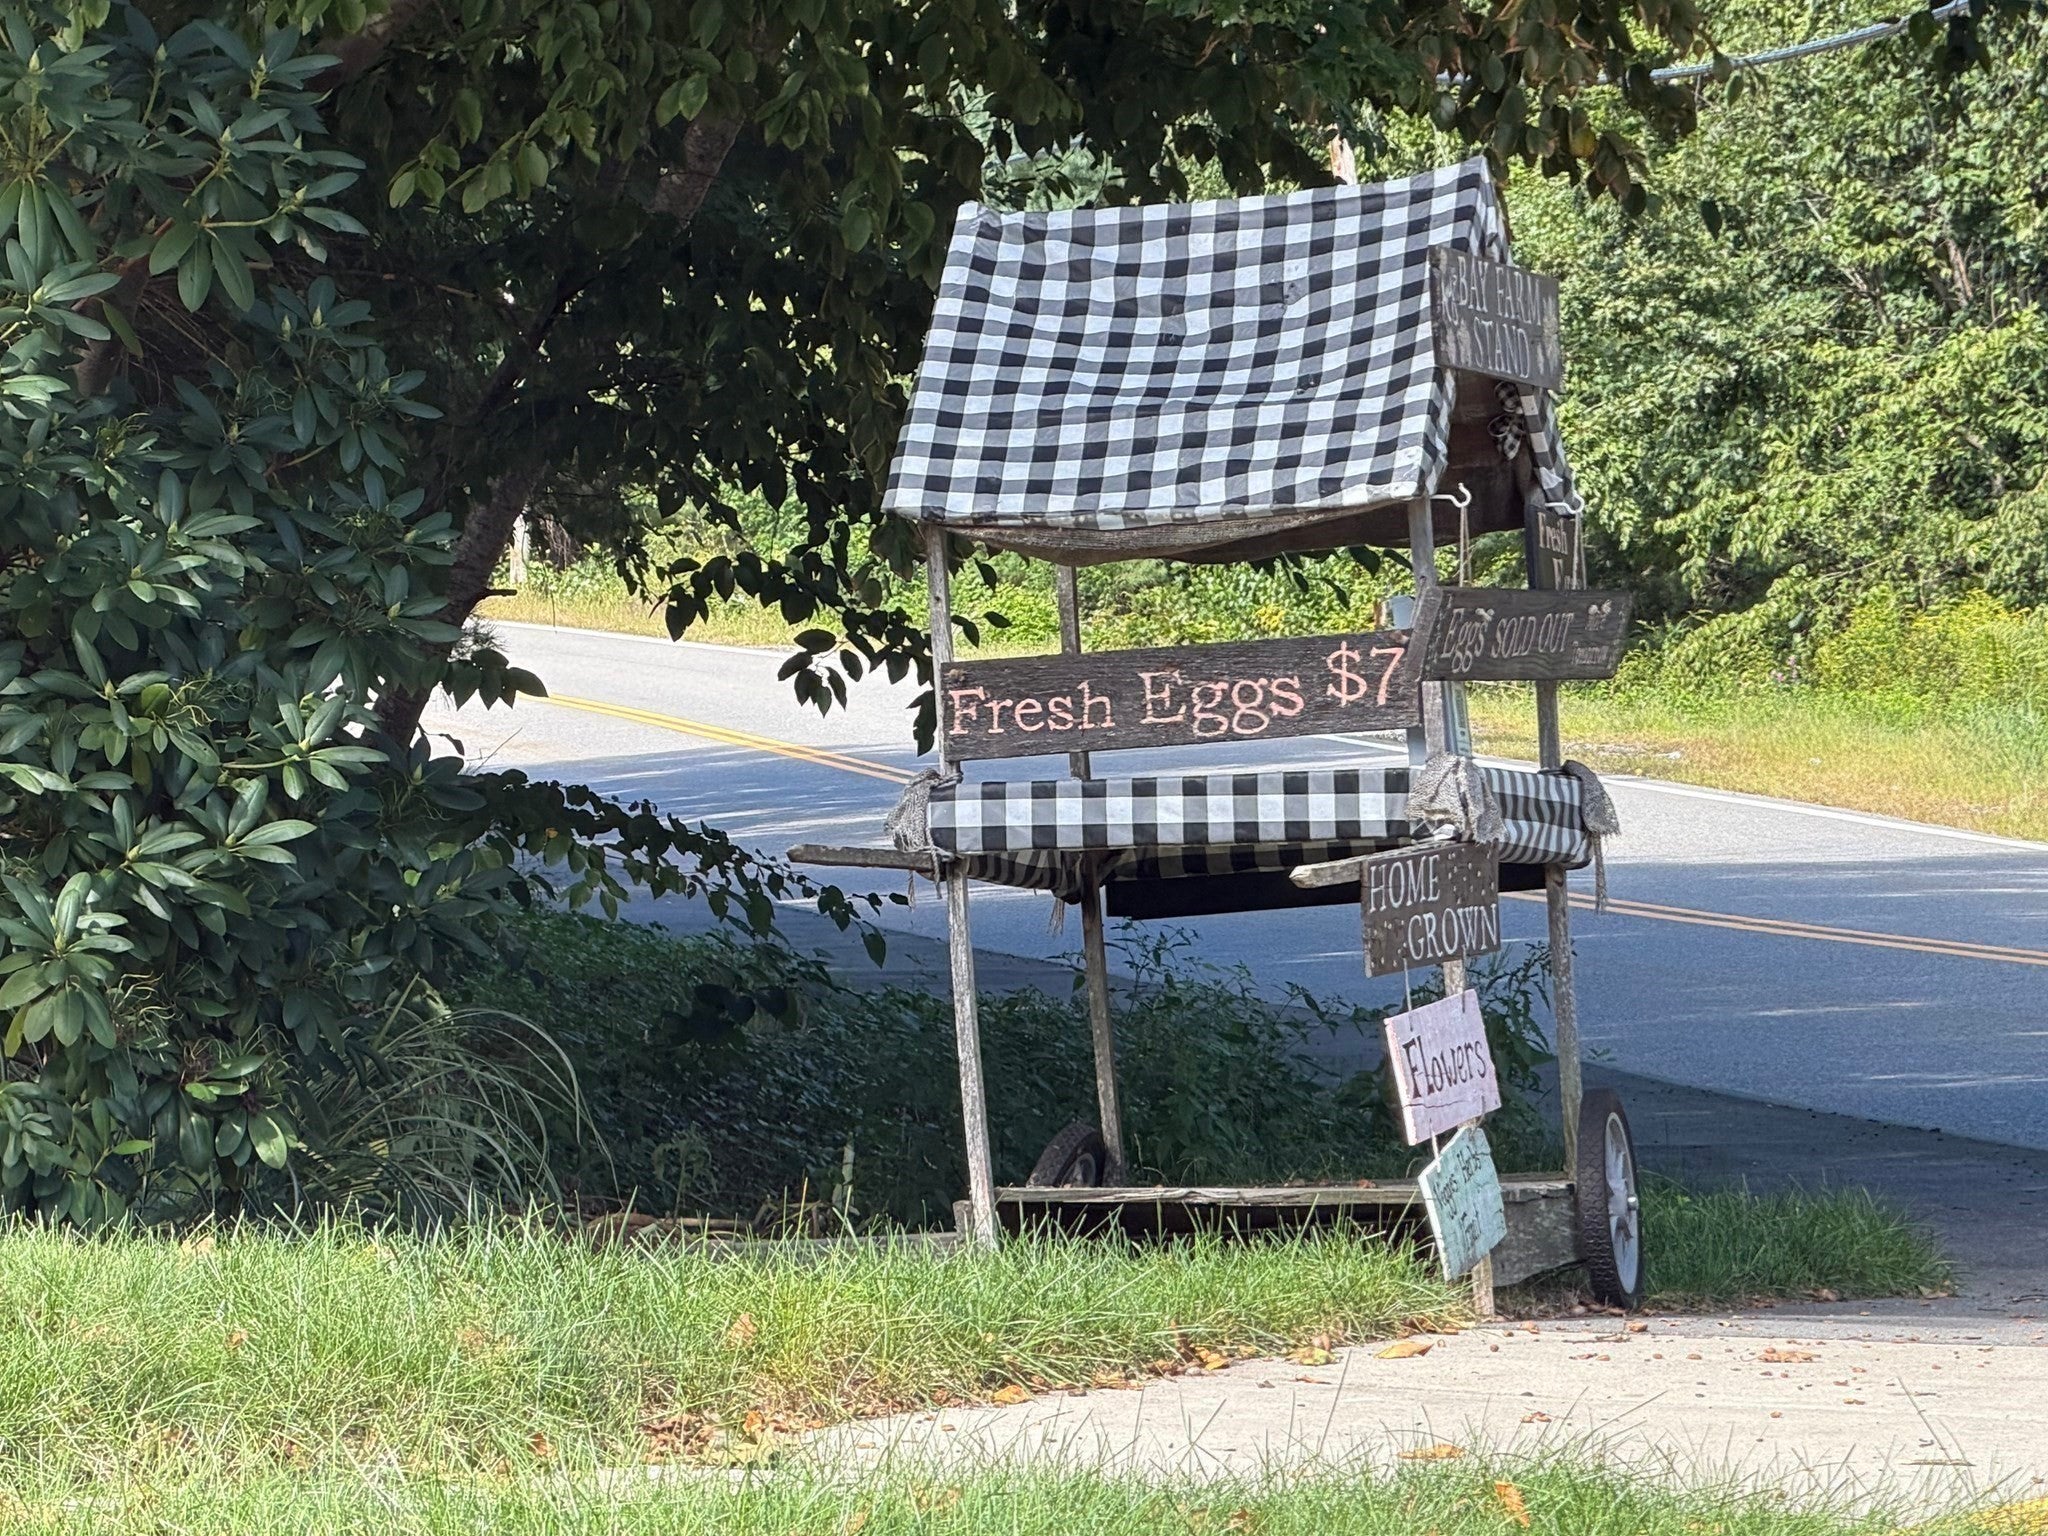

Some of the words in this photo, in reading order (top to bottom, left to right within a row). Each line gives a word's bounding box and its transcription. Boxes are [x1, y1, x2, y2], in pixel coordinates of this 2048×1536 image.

[1458, 256, 1488, 313] BAY
[1496, 266, 1541, 326] FARM
[1474, 317, 1530, 379] STAND
[1492, 616, 1536, 659] SOLD
[1538, 612, 1574, 653] OUT
[949, 680, 1115, 736] Fresh
[1138, 670, 1305, 738] Eggs
[1325, 641, 1405, 707] $7
[1369, 854, 1440, 913] HOME
[1408, 903, 1497, 960] GROWN
[1402, 1035, 1487, 1099] Flowers
